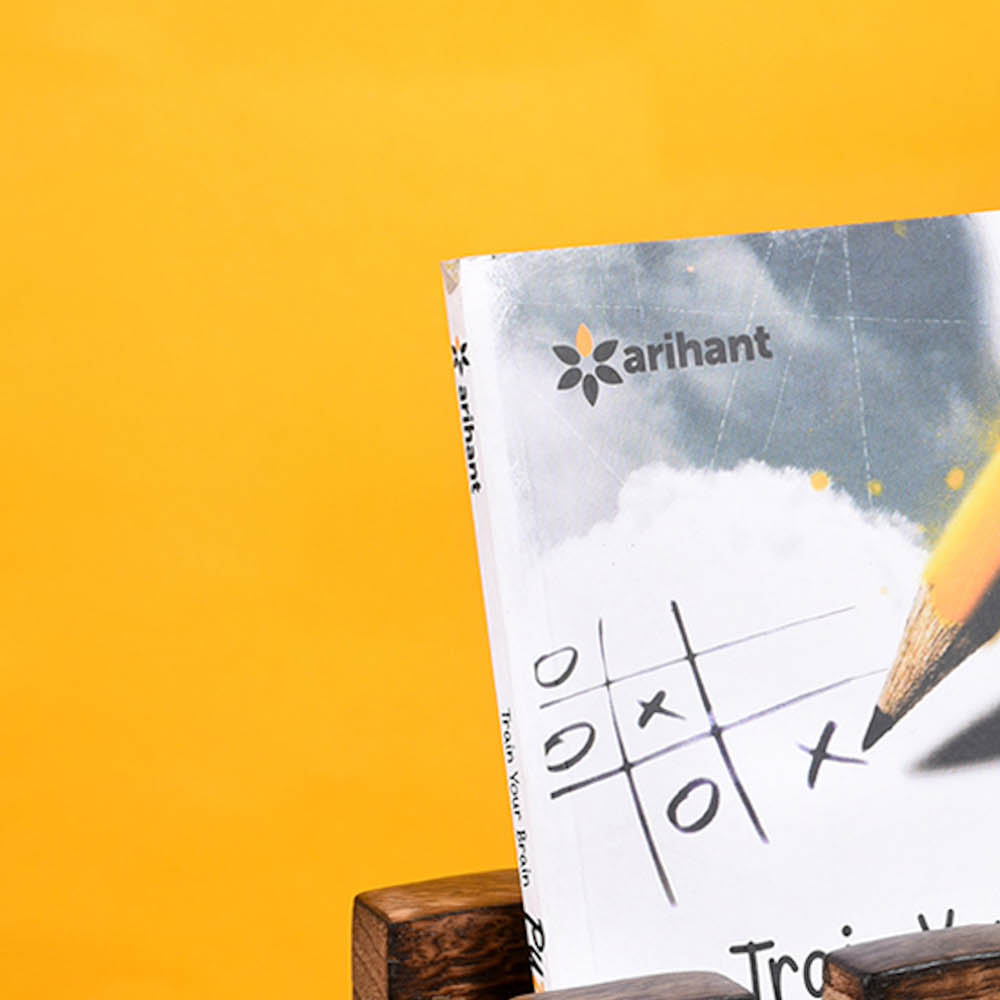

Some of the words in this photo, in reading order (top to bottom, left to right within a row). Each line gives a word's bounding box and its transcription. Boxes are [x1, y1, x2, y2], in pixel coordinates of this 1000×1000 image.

[624, 326, 773, 374] arihant
[458, 385, 481, 493] arihant
[501, 708, 513, 764] Train
[509, 771, 523, 822] Your
[516, 829, 531, 888] Brain
